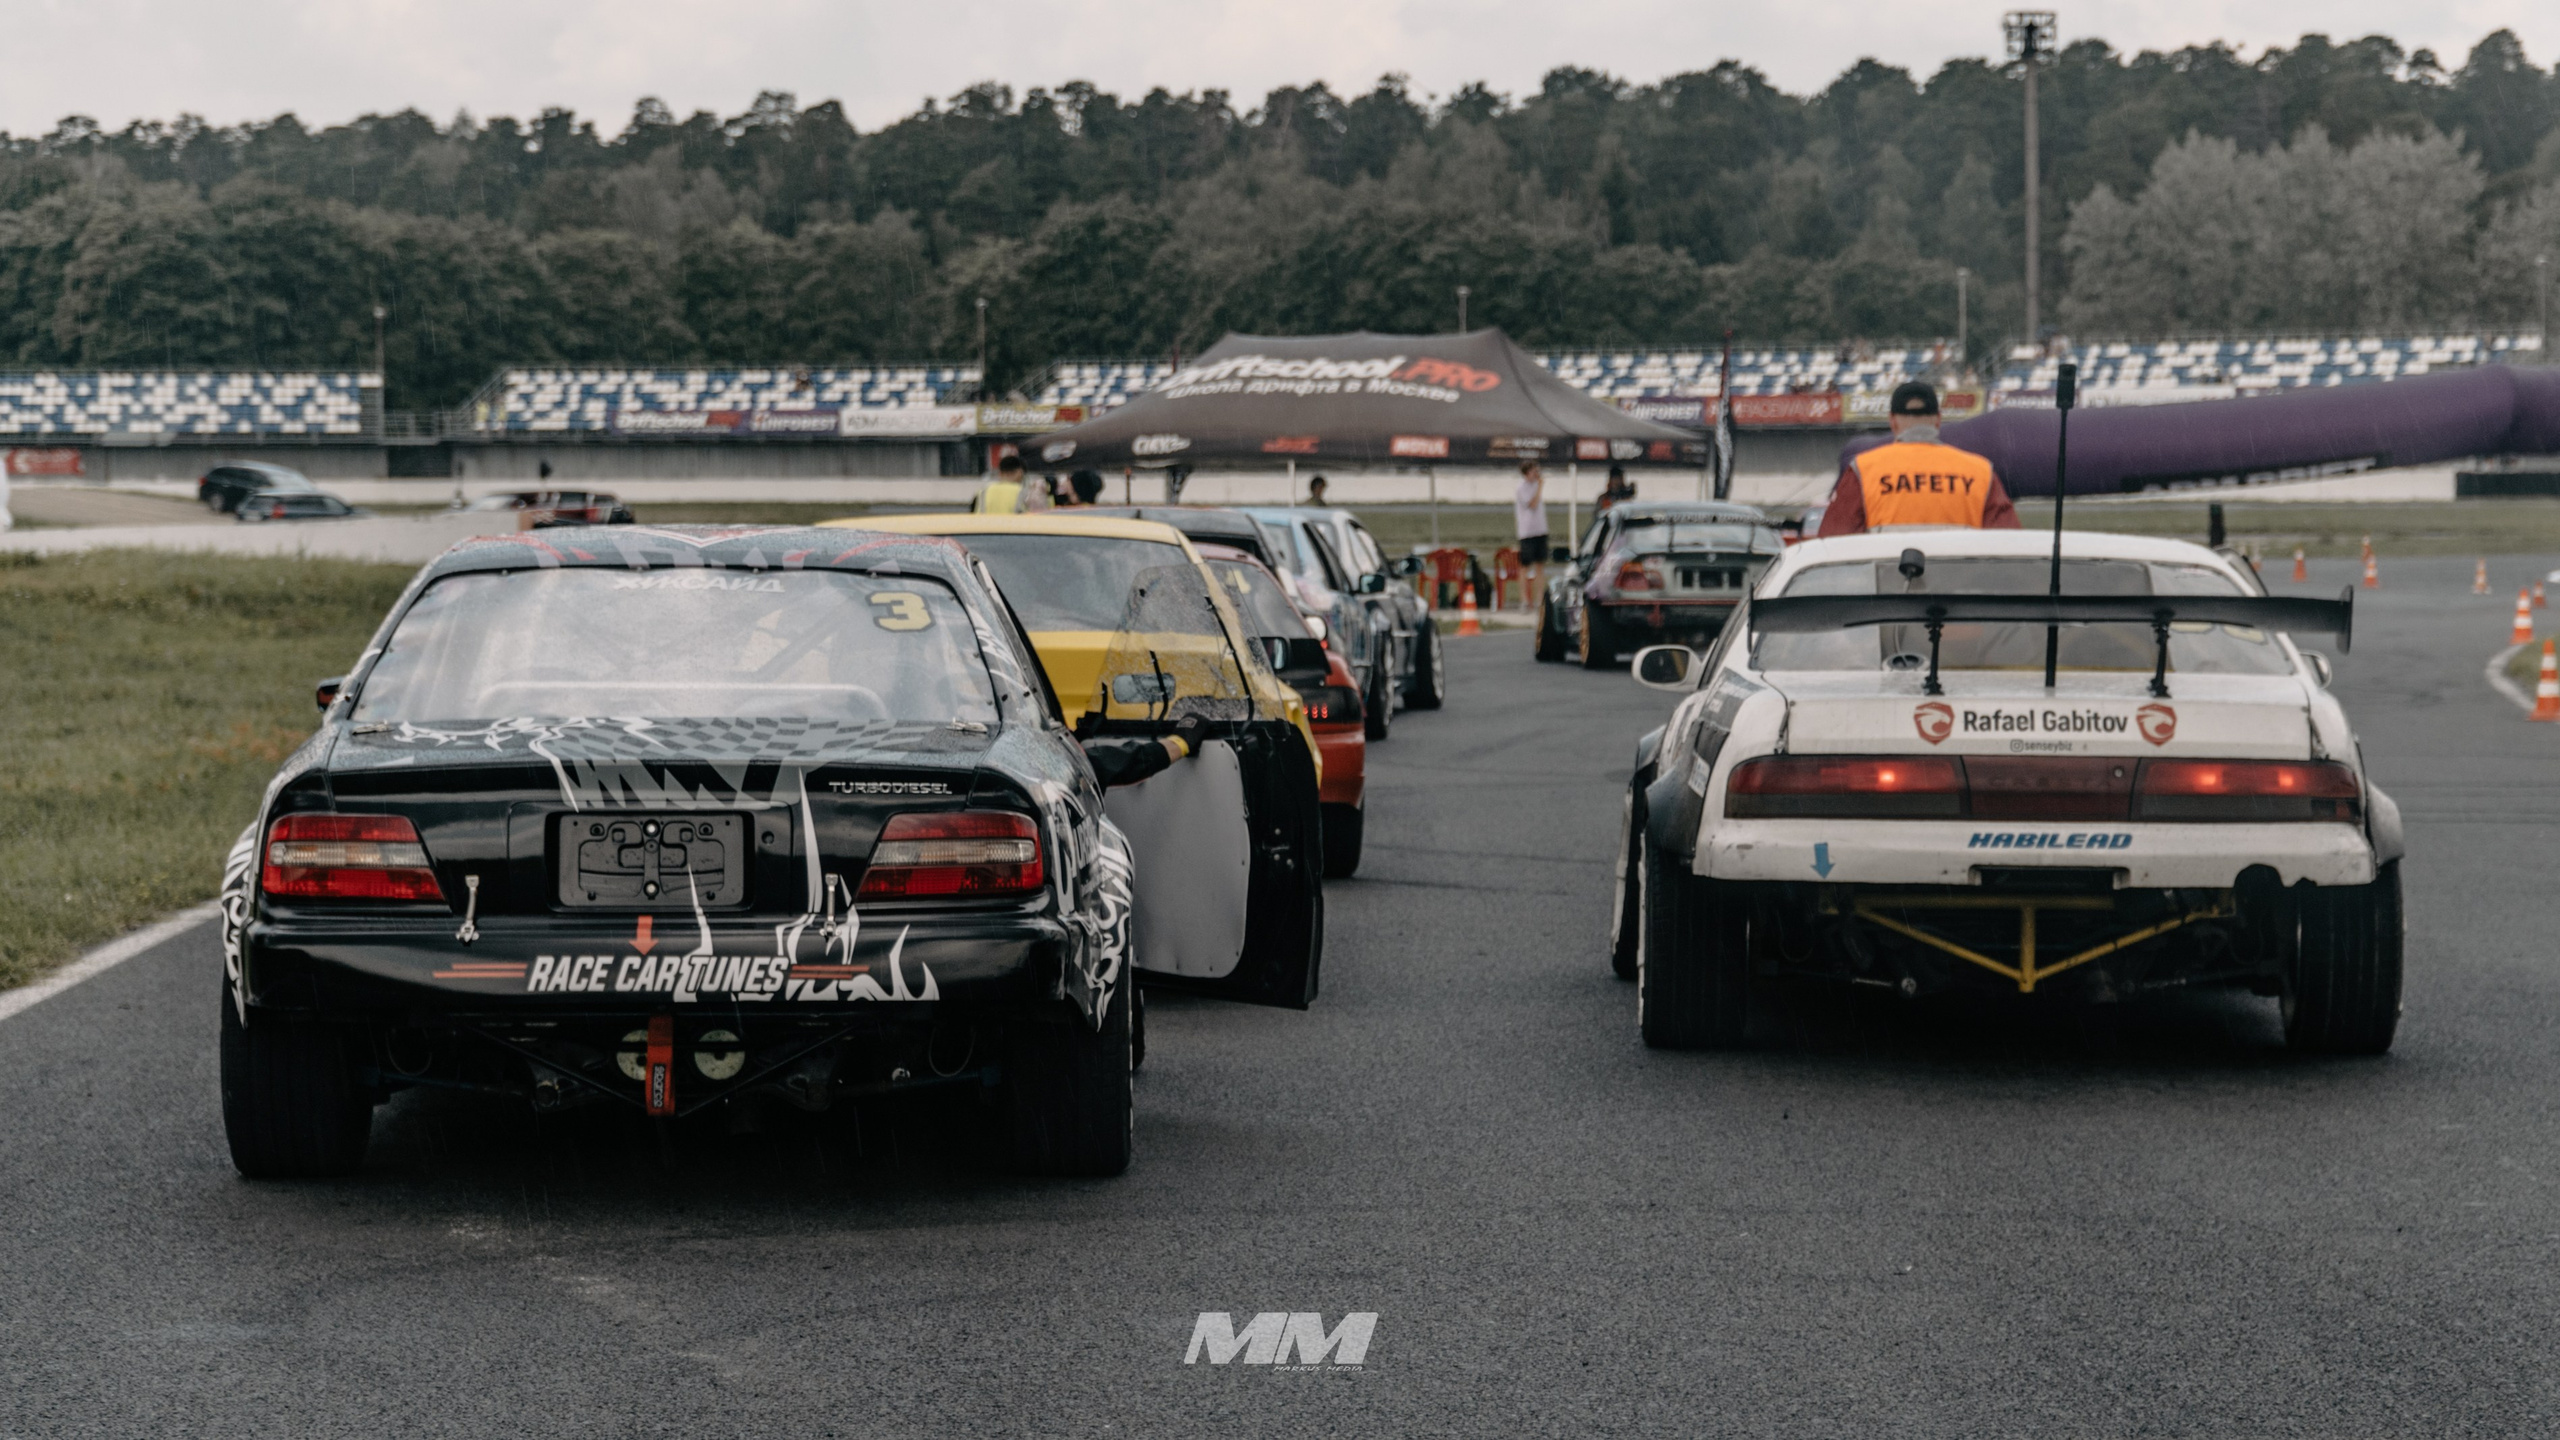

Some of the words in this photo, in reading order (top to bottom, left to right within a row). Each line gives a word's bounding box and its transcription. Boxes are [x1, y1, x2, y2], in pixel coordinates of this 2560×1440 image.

[1366, 377, 1460, 403] Москве
[1880, 473, 1975, 496] SAFETY
[865, 590, 936, 633] 3
[1963, 709, 2035, 732] Rafael
[2042, 709, 2128, 733] Gabitov
[828, 781, 953, 795] TURBODIESEL
[1967, 832, 2133, 849] HABILEAD
[527, 955, 615, 993] RACE
